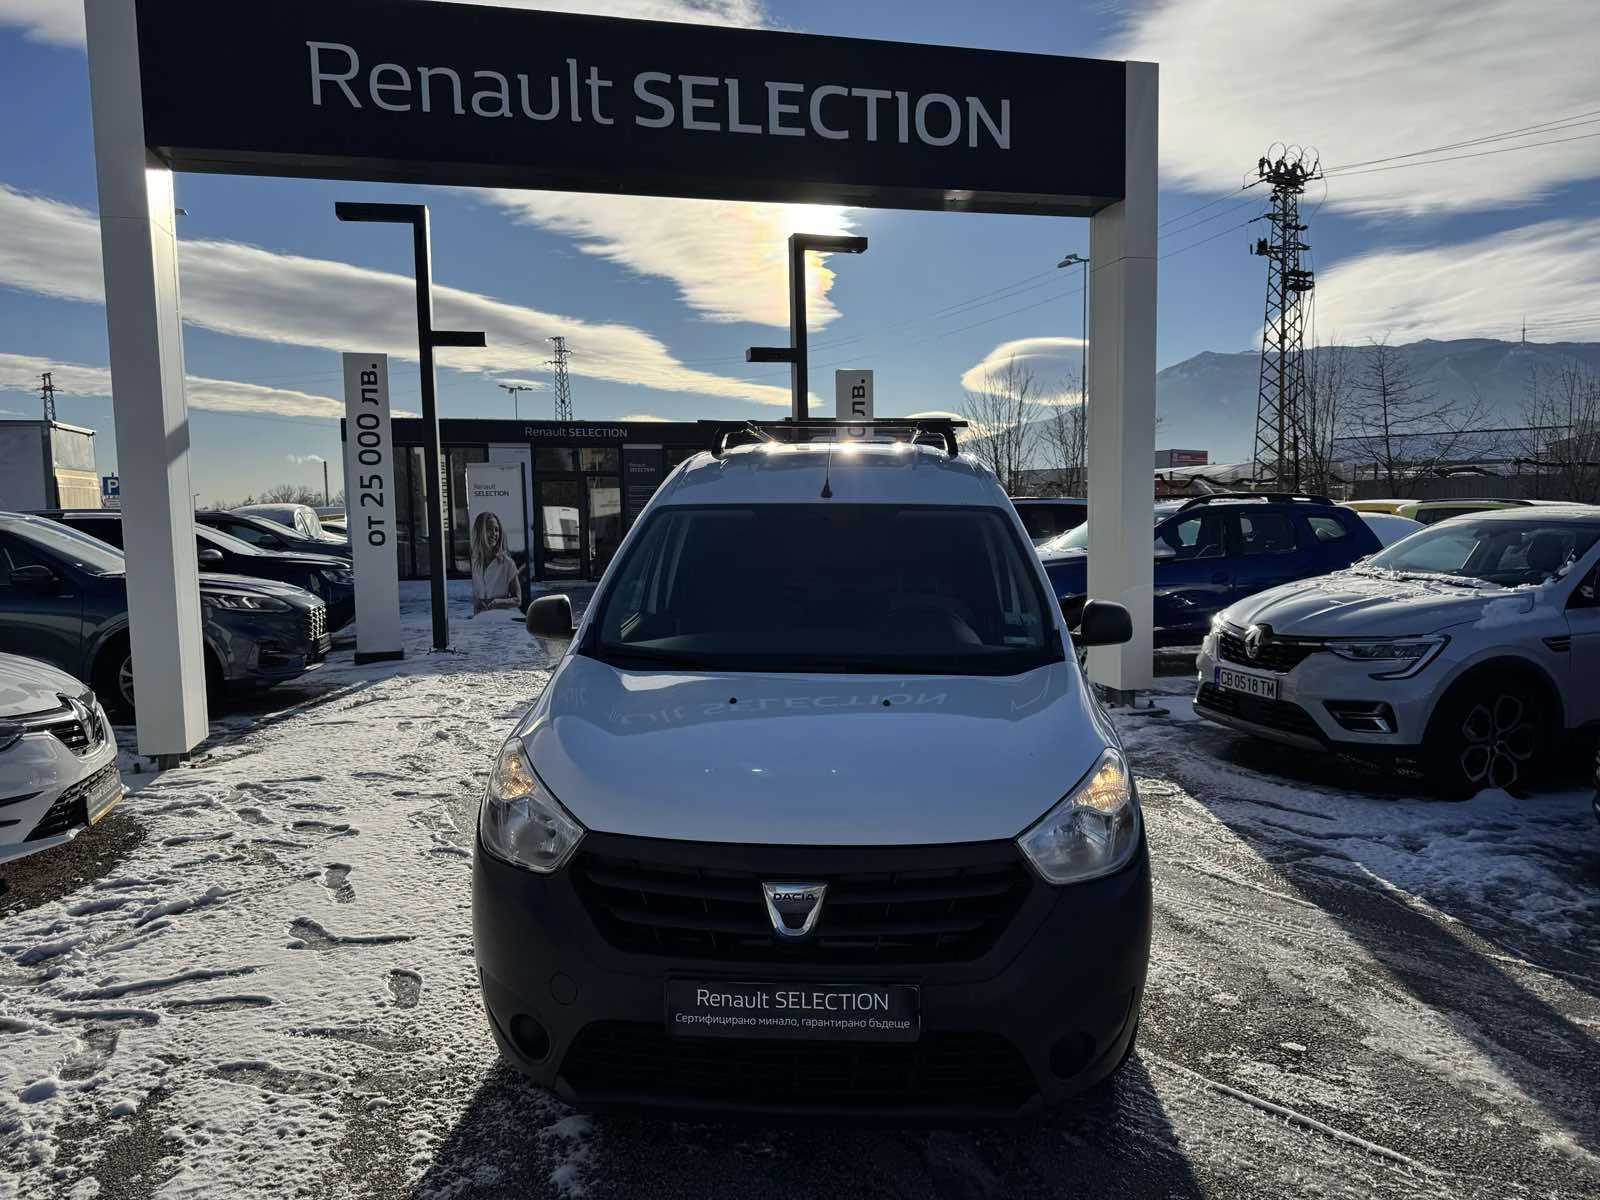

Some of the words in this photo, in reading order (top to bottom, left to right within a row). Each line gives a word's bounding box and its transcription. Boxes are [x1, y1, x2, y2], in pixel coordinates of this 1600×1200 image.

[306, 41, 614, 125] Renault
[633, 71, 1011, 150] SELECTION
[356, 413, 382, 466] 000
[524, 427, 566, 437] Renault
[568, 428, 628, 438] SELECTION
[107, 479, 119, 494] P
[359, 474, 384, 508] 25
[368, 516, 386, 546] от
[1221, 671, 1233, 687] CB
[1234, 674, 1258, 693] 0518
[1260, 680, 1275, 697] TM
[773, 893, 816, 901] DACIA
[696, 989, 770, 1009] Renault
[775, 991, 890, 1011] SELECTION
[675, 1012, 757, 1027] Сертифицирано
[758, 1016, 800, 1028] минало,
[801, 1017, 867, 1030] гарантирано
[868, 1016, 912, 1030] бъдеще
